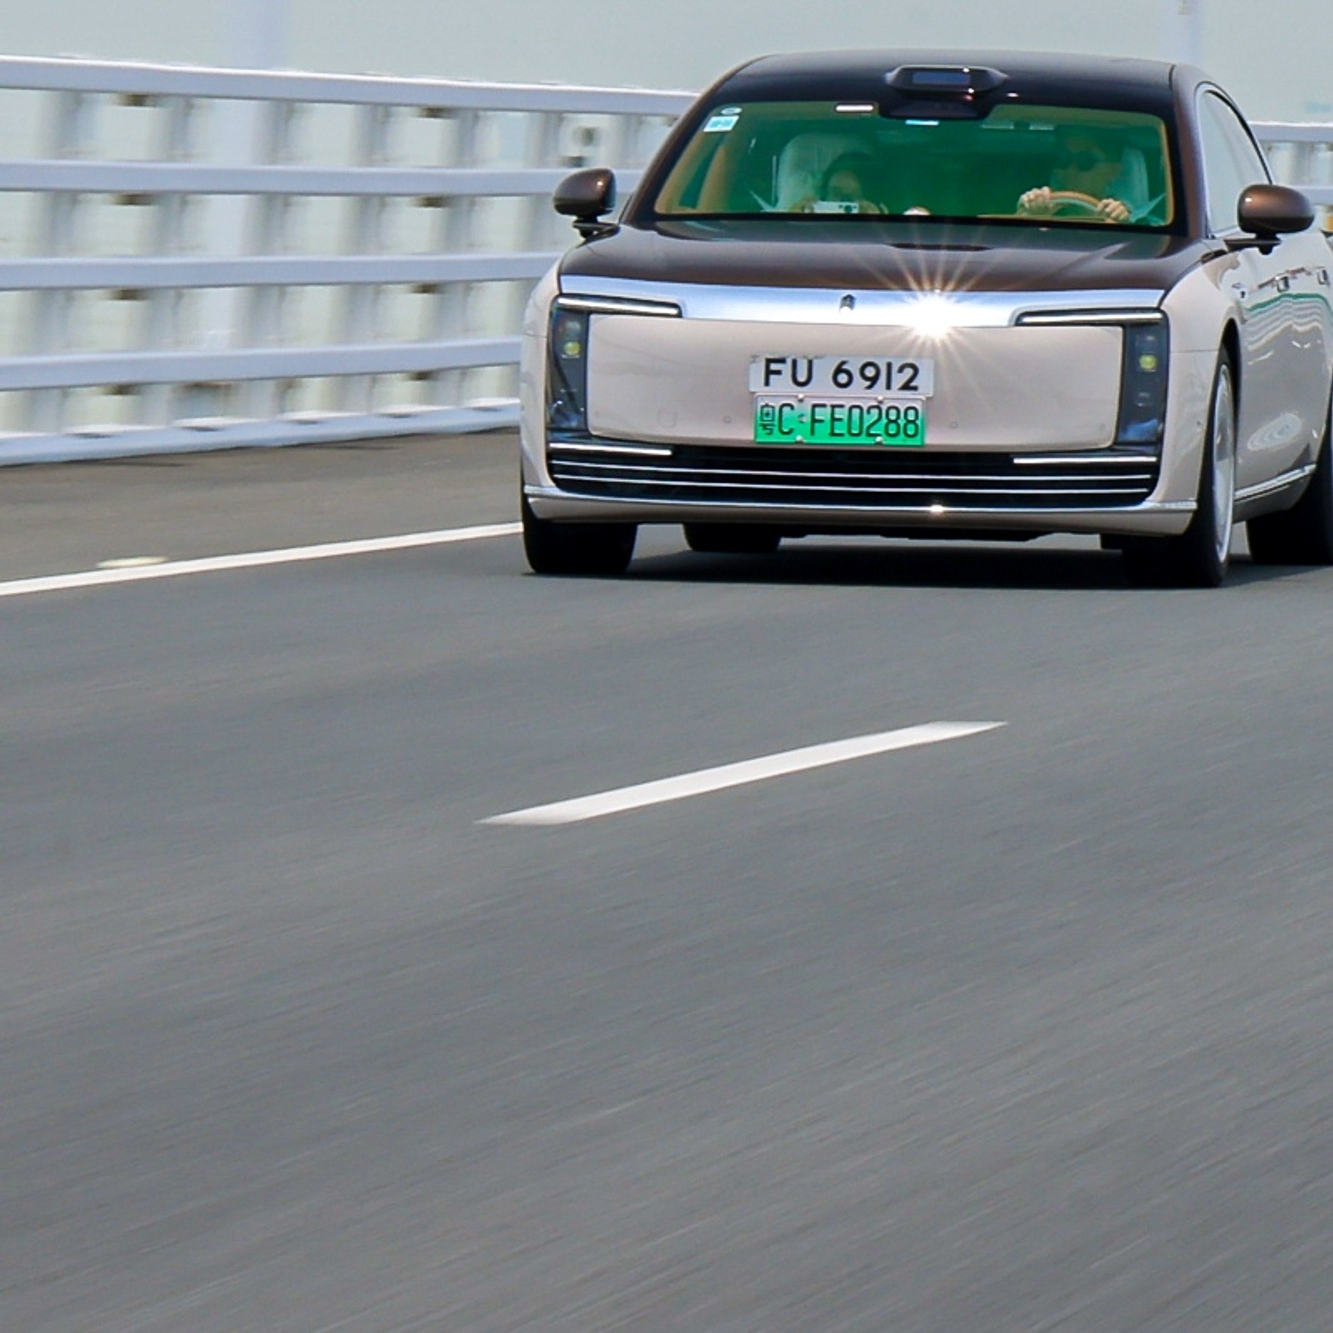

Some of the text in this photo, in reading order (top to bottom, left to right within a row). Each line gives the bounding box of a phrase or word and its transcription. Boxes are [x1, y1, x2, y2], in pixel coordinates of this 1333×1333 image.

[763, 357, 920, 392] FU 6912
[809, 403, 920, 439] FE0288
